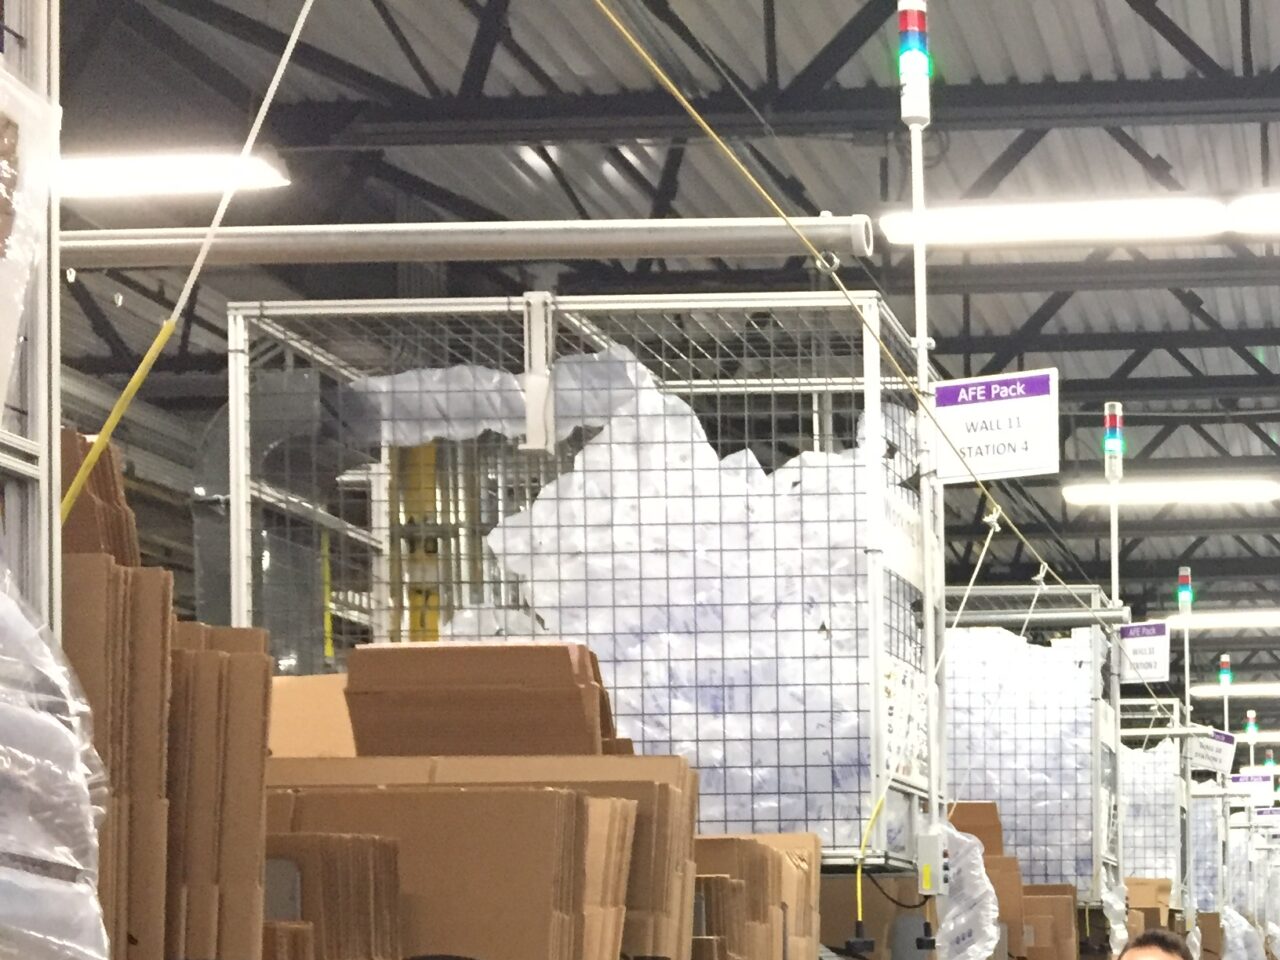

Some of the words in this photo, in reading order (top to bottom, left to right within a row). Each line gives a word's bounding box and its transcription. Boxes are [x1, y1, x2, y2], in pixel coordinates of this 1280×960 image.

[957, 385, 986, 402] AFE
[990, 381, 1026, 399] Pack
[965, 419, 1002, 433] WALL
[1008, 416, 1022, 429] 11
[959, 442, 1017, 458] STATION
[1021, 440, 1029, 452] 4
